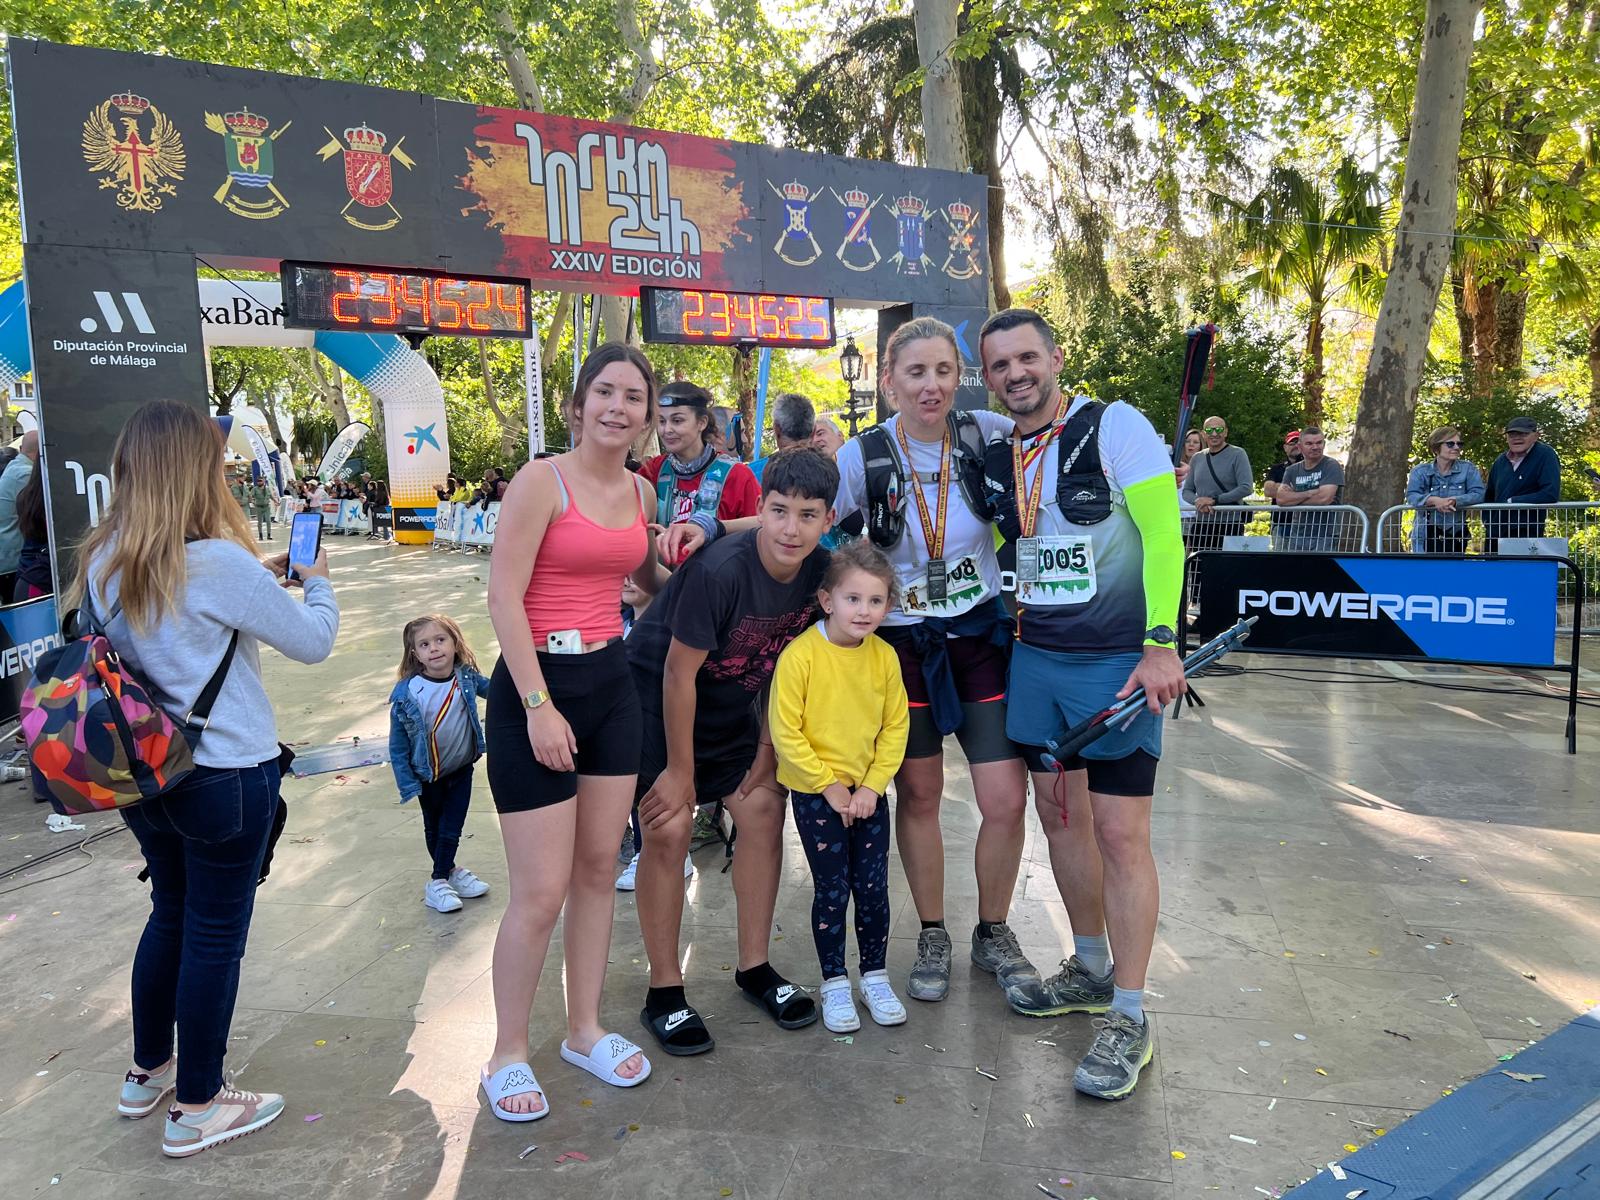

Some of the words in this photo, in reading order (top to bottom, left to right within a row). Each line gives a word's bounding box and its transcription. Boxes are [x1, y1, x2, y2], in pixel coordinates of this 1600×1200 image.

[551, 250, 605, 272] XXIV
[612, 256, 701, 279] EDICIÓN
[333, 270, 524, 331] 23:45:24
[683, 291, 828, 339] 23:45:25
[53, 340, 124, 352] Diputación
[127, 341, 187, 353] Provincial
[90, 355, 106, 365] de
[110, 355, 157, 368] Málaga
[1038, 546, 1087, 570] 005
[1238, 589, 1508, 624] POWERADE
[668, 1009, 689, 1024] NIKE
